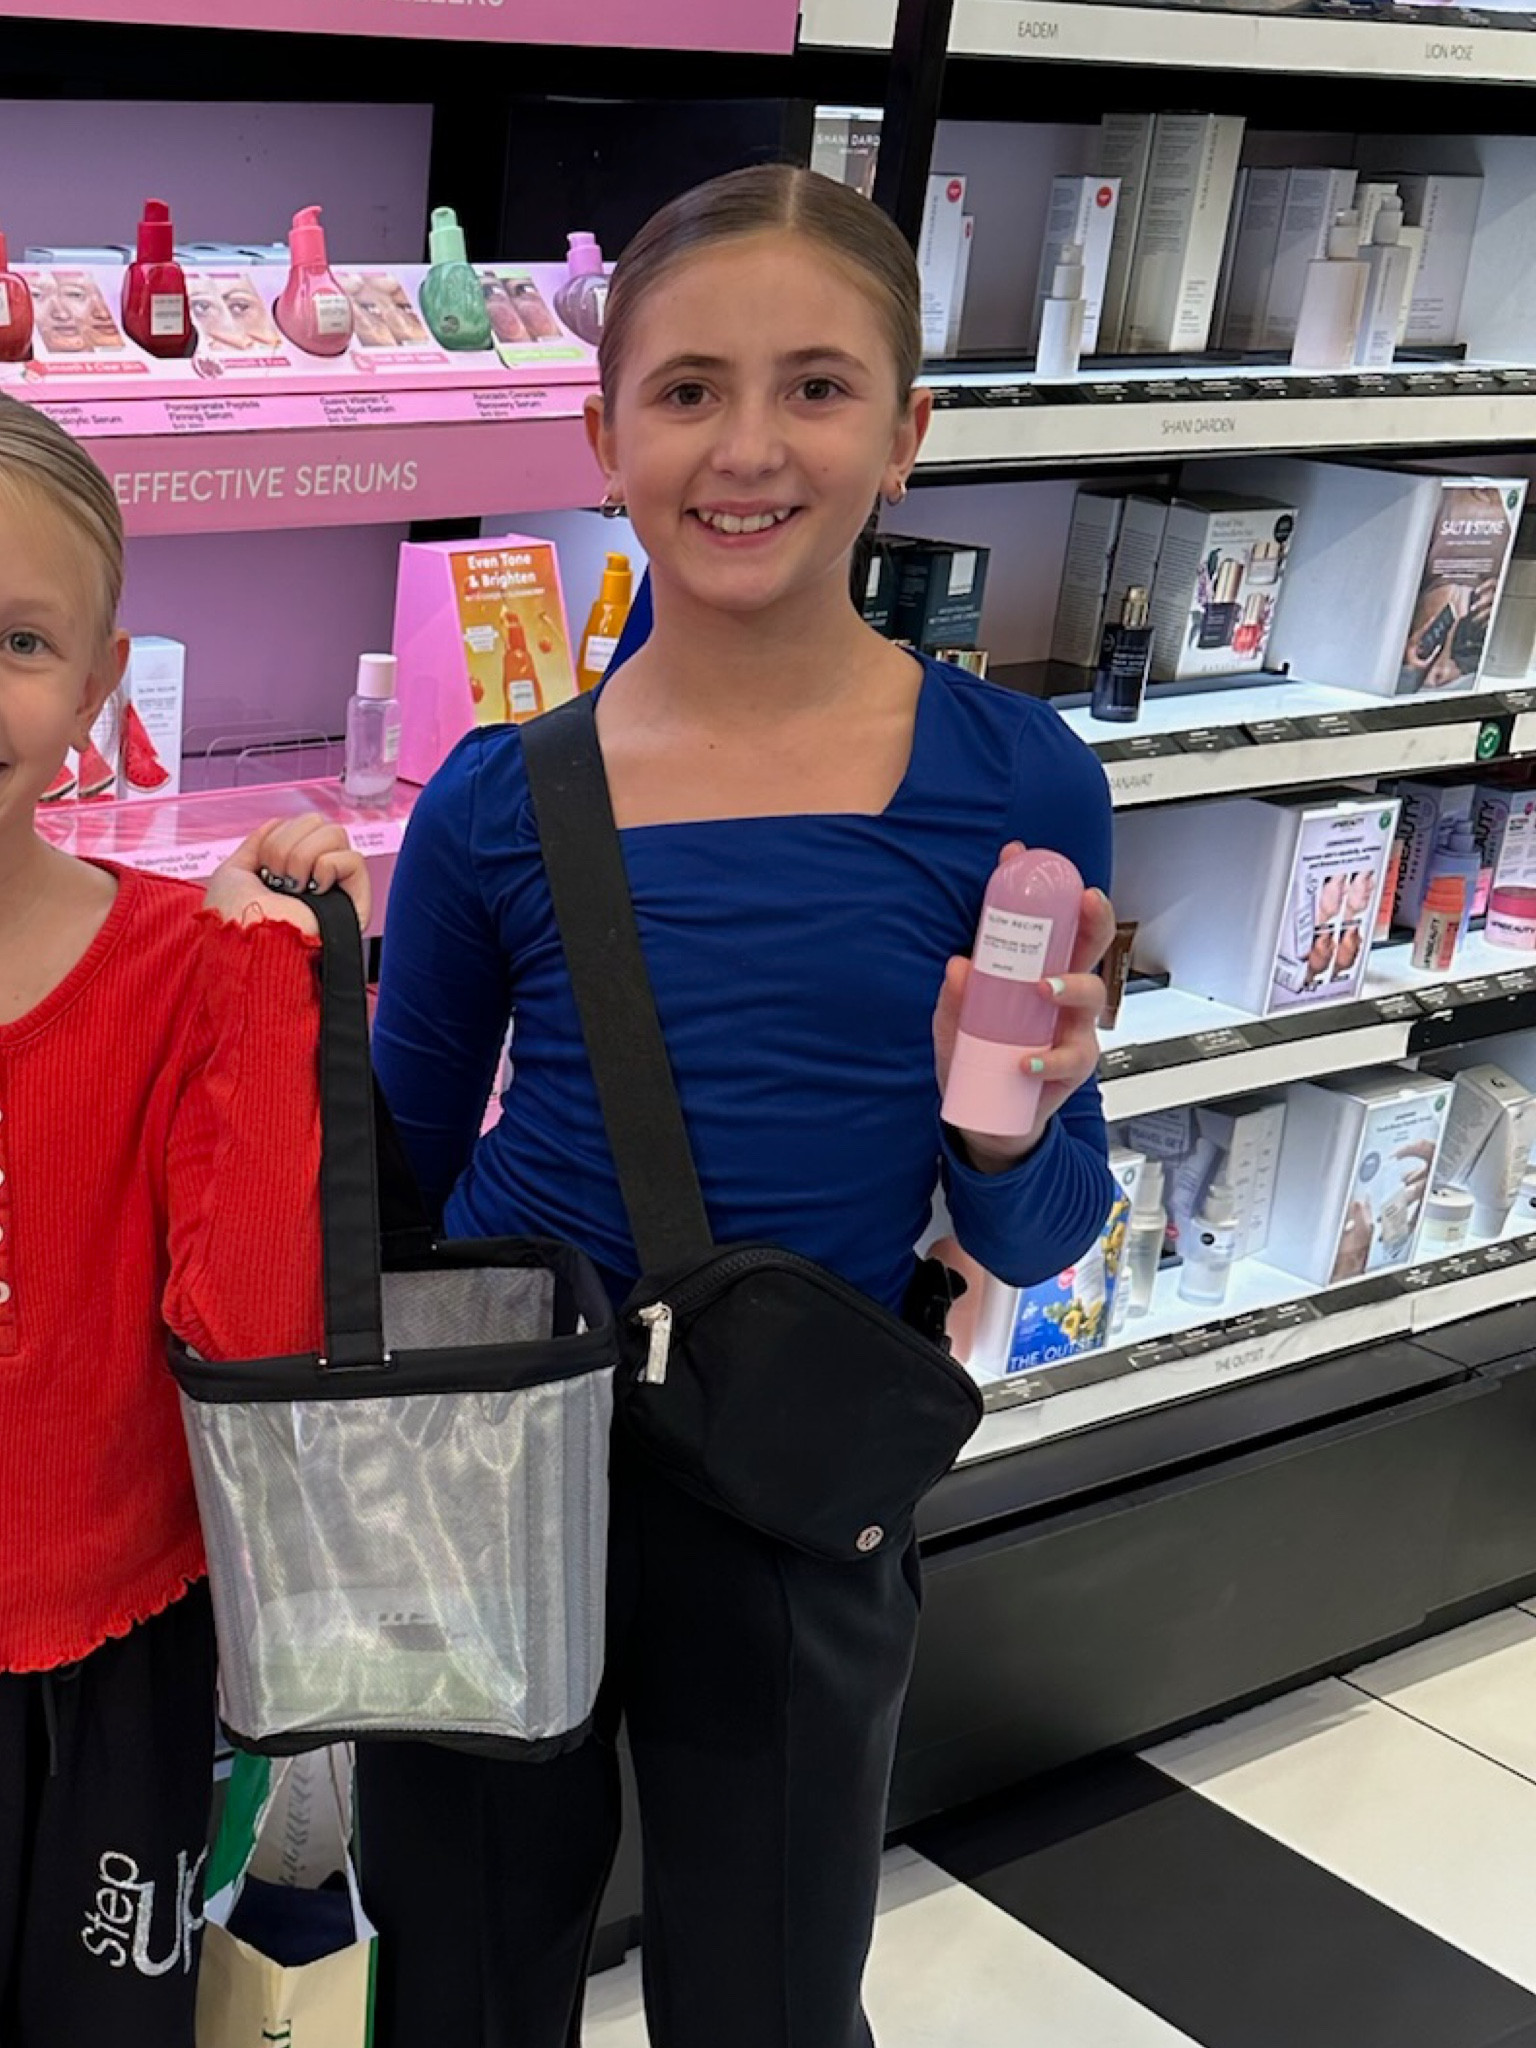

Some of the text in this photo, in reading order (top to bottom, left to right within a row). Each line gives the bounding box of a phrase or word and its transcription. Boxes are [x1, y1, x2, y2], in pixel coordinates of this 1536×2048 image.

[1017, 20, 1060, 39] EADEM
[204, 410, 233, 420] Serum
[1161, 416, 1238, 435] SHANI DARDEN
[112, 459, 419, 505] EFFECTIVE SERUMS
[467, 552, 532, 570] Even Tone
[468, 570, 537, 588] & Brighten
[1011, 919, 1044, 932] RECIPE
[1009, 1353, 1042, 1372] THE
[80, 1850, 141, 1968] Step
